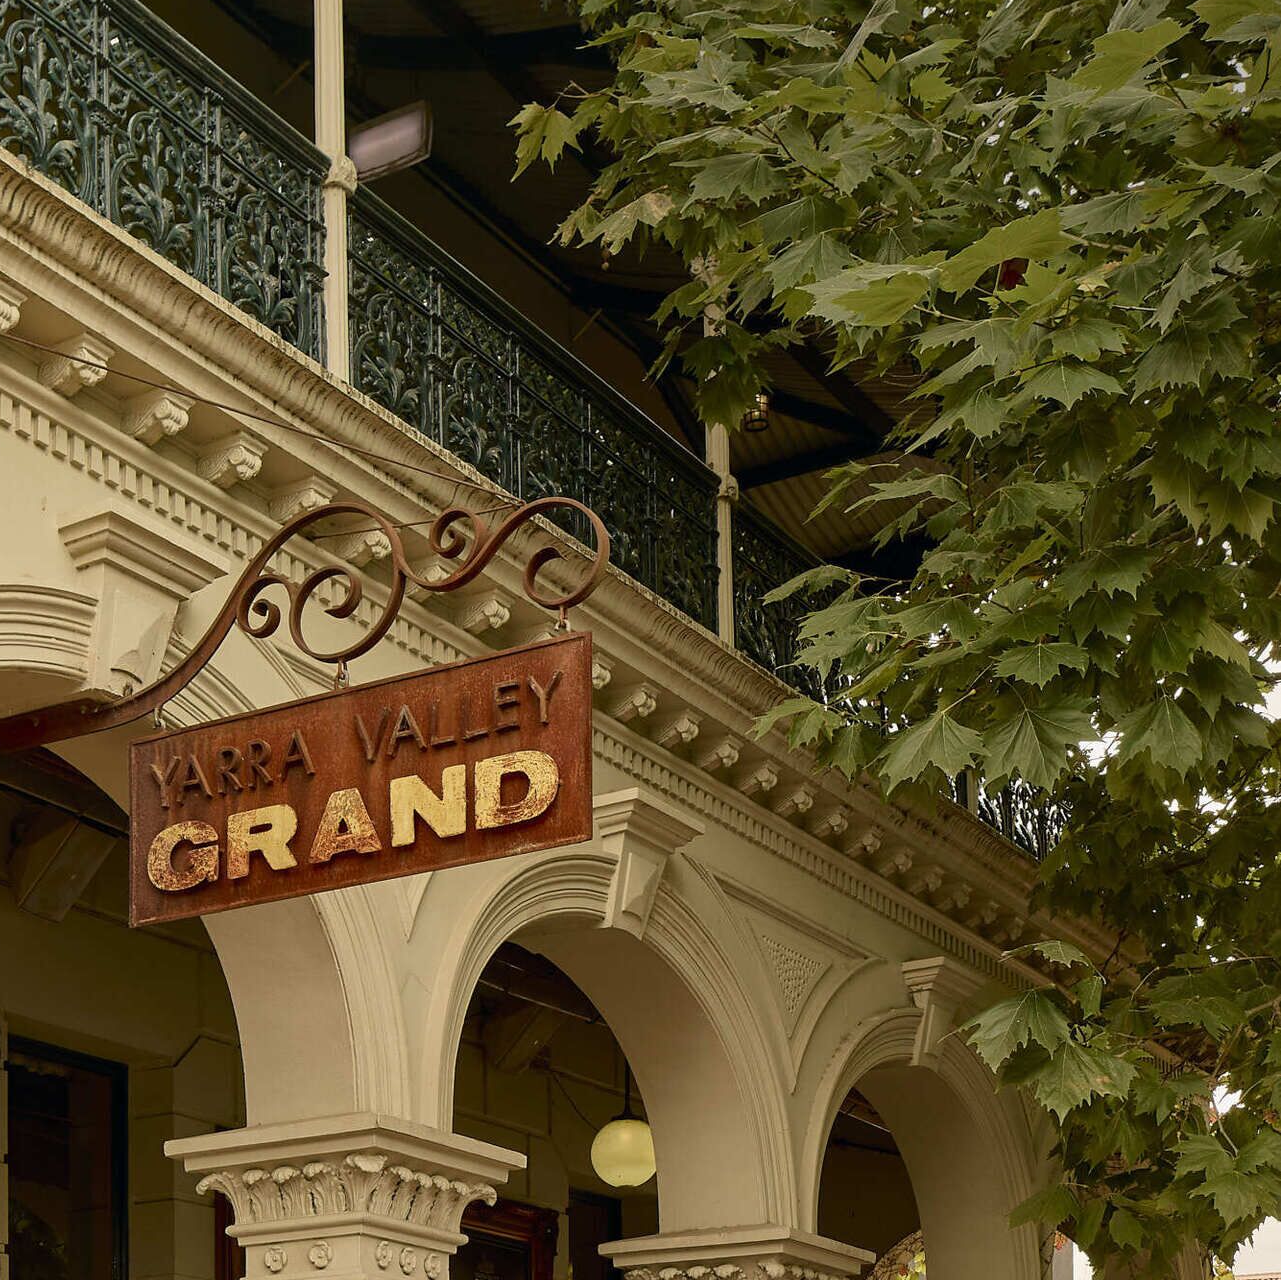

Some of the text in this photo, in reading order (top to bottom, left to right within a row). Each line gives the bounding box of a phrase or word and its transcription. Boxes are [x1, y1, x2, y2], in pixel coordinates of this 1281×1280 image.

[150, 670, 564, 808] YARRA VALLEY
[147, 749, 560, 892] GRAND
